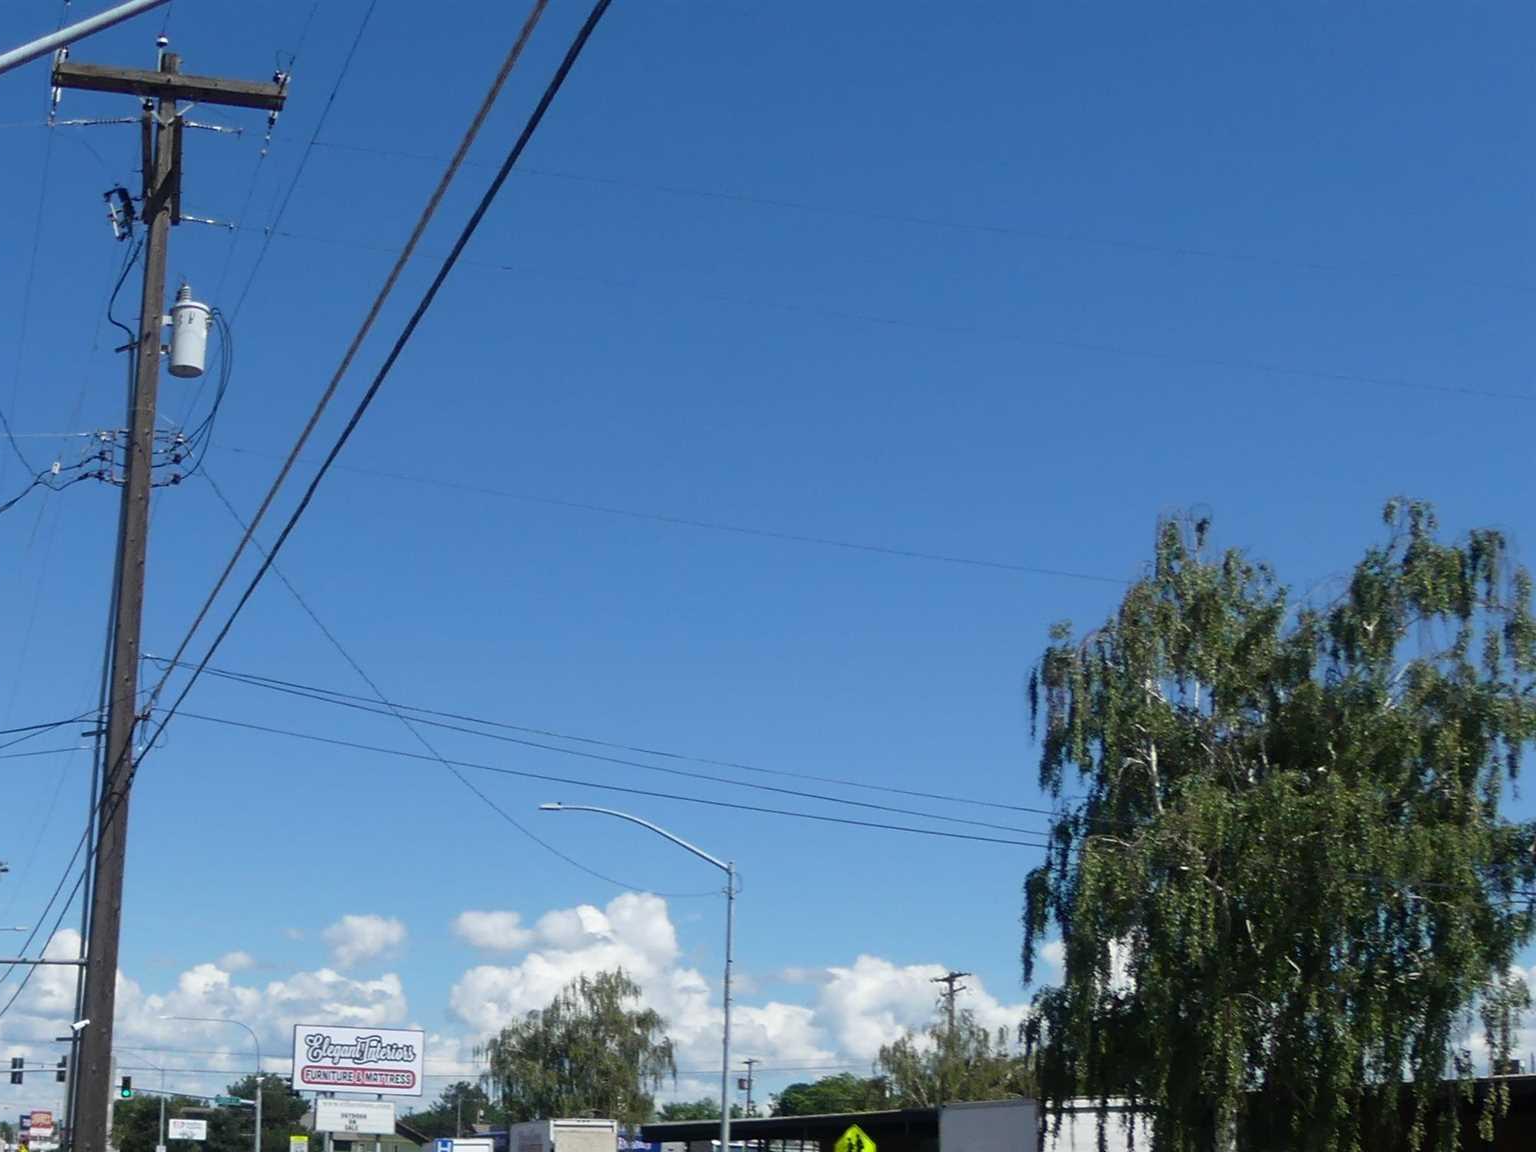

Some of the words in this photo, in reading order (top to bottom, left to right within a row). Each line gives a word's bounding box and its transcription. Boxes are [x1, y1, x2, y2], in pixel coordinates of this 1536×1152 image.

[305, 1033, 363, 1065] Elegant
[353, 1035, 416, 1065] Interiors
[305, 1069, 353, 1082] FURNITURE
[355, 1071, 362, 1083] &
[365, 1072, 411, 1085] MATTRESS
